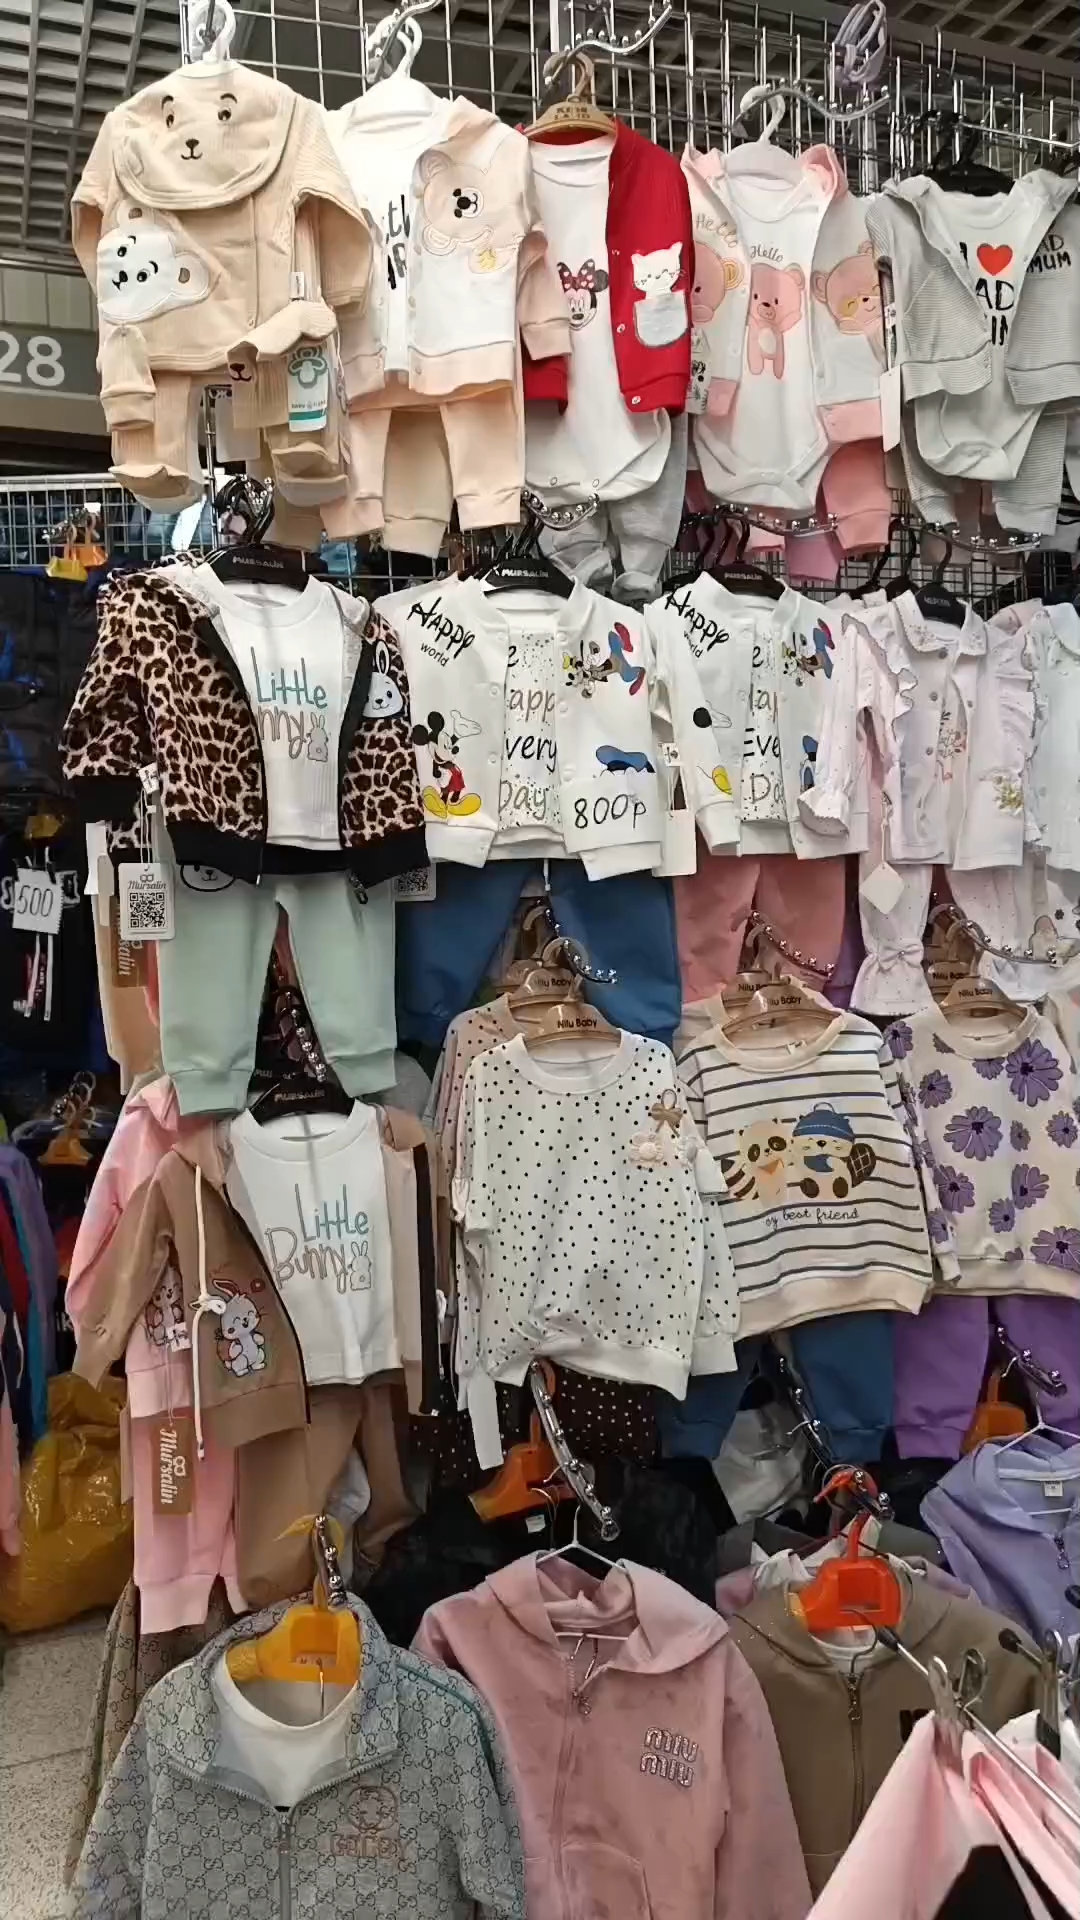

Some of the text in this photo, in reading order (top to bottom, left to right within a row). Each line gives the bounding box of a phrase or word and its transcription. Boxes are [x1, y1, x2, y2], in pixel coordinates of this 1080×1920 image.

[750, 243, 784, 262] Hello
[975, 278, 1015, 310] AD
[420, 642, 450, 667] world
[250, 646, 328, 709] Little
[509, 688, 556, 723] app
[256, 705, 306, 759] nny
[743, 727, 781, 758] Eve
[505, 735, 557, 773] very
[750, 773, 783, 804] Da
[17, 885, 53, 917] 500
[294, 1183, 369, 1242] Little
[782, 1207, 812, 1221] best
[816, 1207, 860, 1225] friend
[264, 1226, 349, 1295] Bunny
